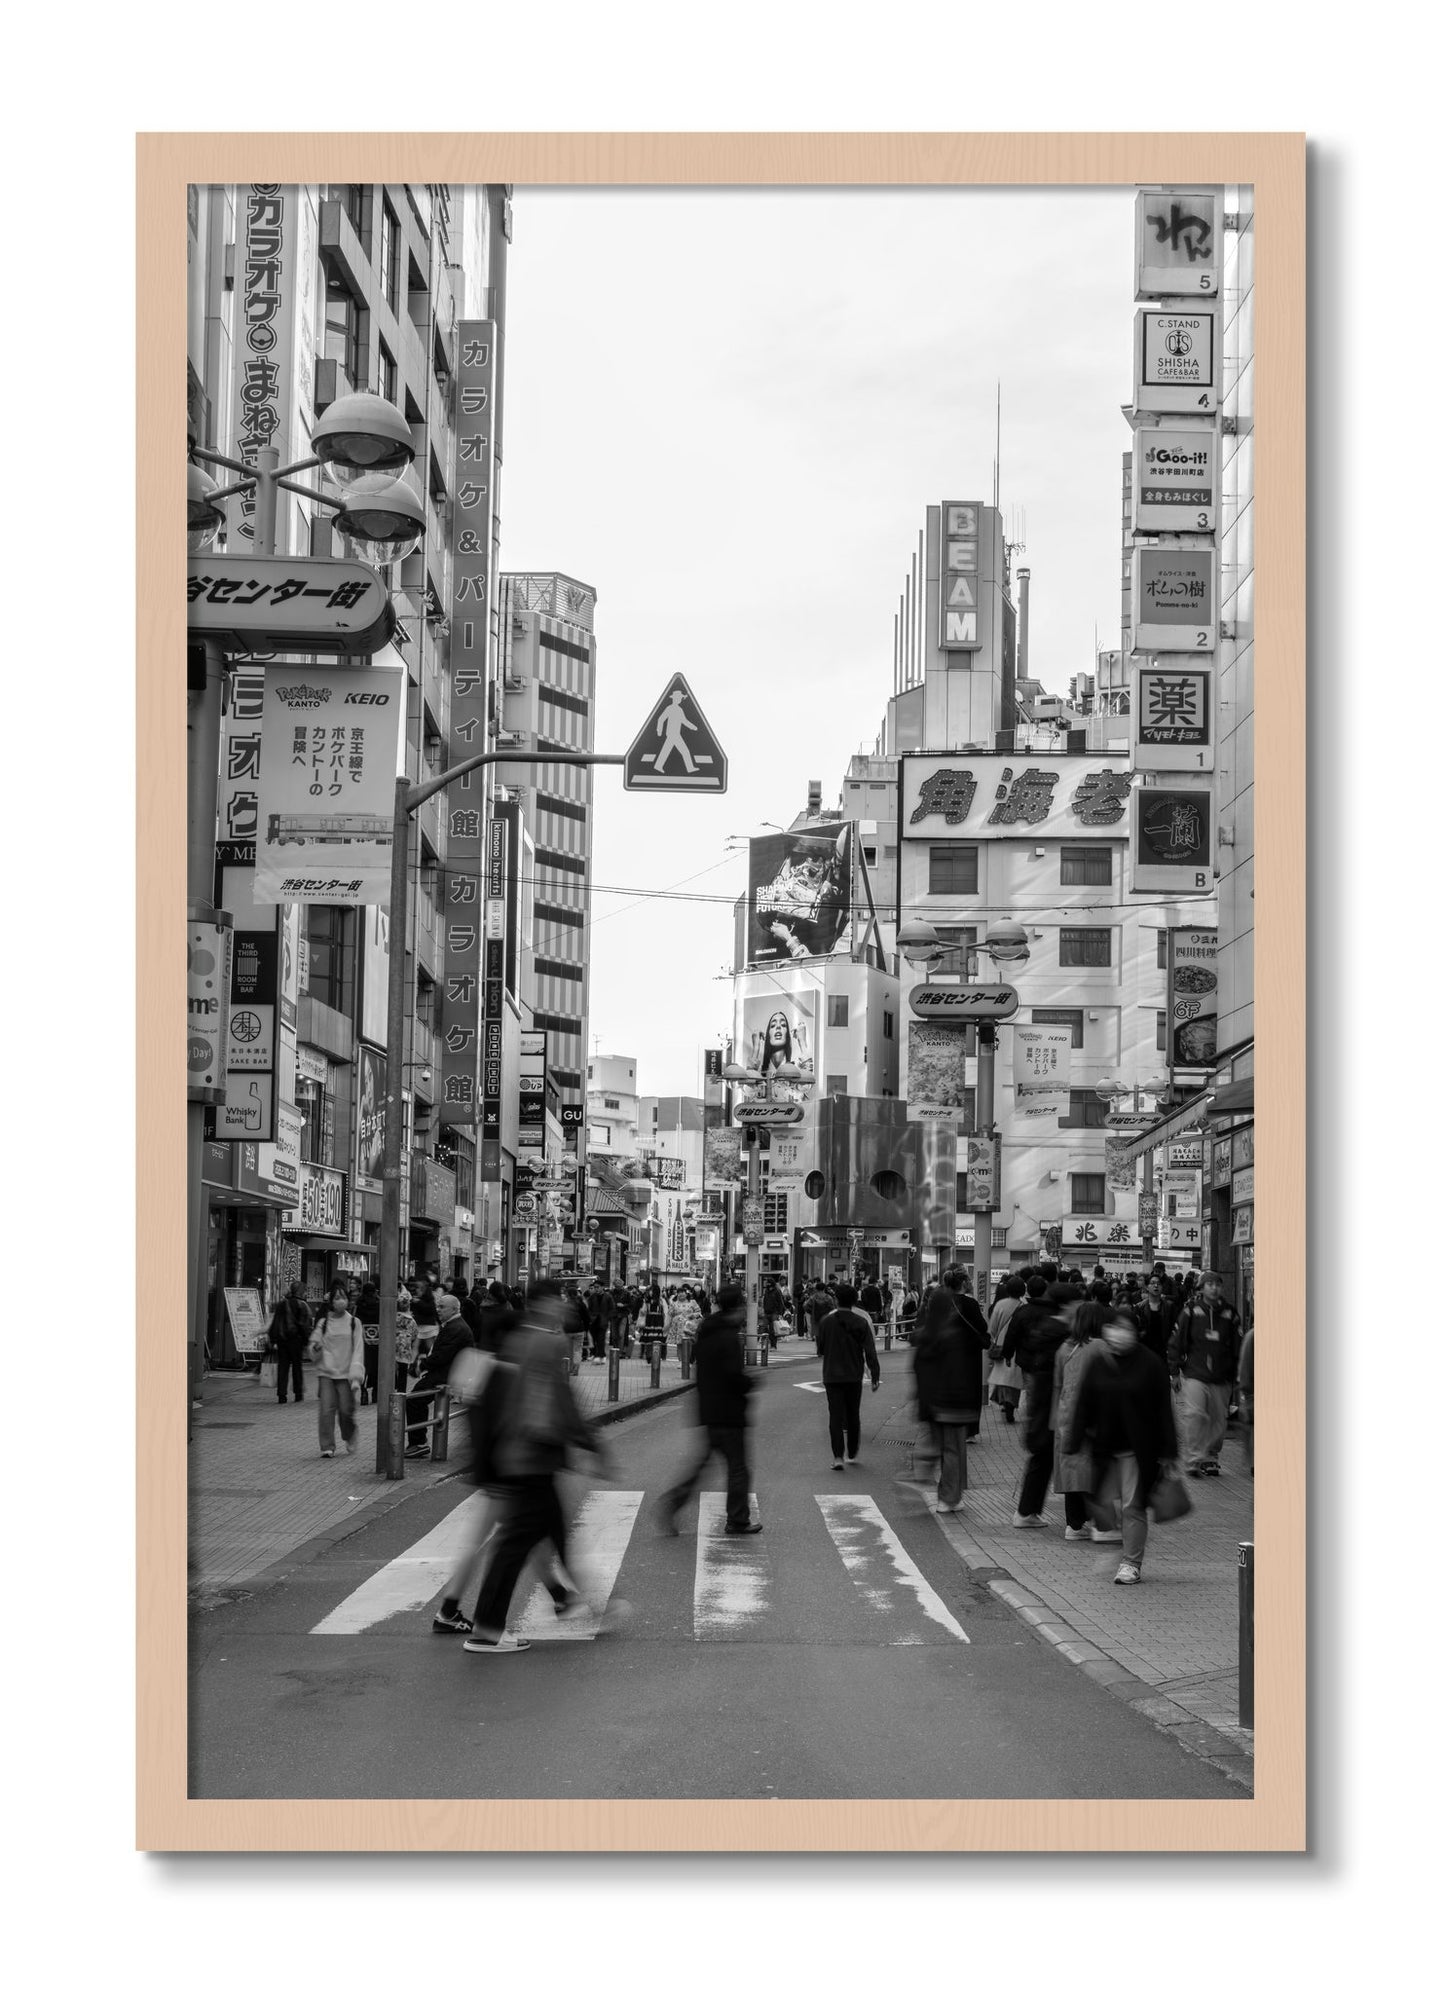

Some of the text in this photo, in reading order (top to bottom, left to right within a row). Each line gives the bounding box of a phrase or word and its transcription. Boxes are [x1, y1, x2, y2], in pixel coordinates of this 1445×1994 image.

[245, 196, 284, 324] カラオケ
[1200, 275, 1210, 289] 5
[1158, 320, 1200, 328] C.STAND
[1158, 358, 1200, 367] SHISHA
[1158, 368, 1199, 376] CAFE&BAR
[1198, 393, 1209, 408] 4
[1156, 449, 1207, 464] Goo-it!
[1145, 491, 1208, 502] 全身もみほぐし
[1197, 513, 1208, 529] 3
[946, 506, 978, 642] BEAM
[1197, 632, 1208, 646] 2
[344, 693, 390, 705] KEIO
[1149, 677, 1196, 725] 薬
[292, 726, 307, 766] 冒険へ
[309, 727, 326, 796] カントーの
[349, 727, 364, 783] 京王線で
[1196, 752, 1204, 767] 1
[493, 824, 502, 894] kimono hearts
[280, 879, 363, 891] 渋谷センター街
[1195, 873, 1206, 887] B
[444, 876, 477, 1104] カラオケ館
[490, 969, 499, 1014] union
[915, 993, 1013, 1005] 渋谷センター街
[1174, 1001, 1201, 1019] 6F
[226, 1107, 257, 1118] Whisky
[563, 1110, 582, 1121] GU
[737, 1107, 796, 1116] 渋谷センター街
[225, 1116, 245, 1124] Bank
[674, 1220, 683, 1260] BEER
